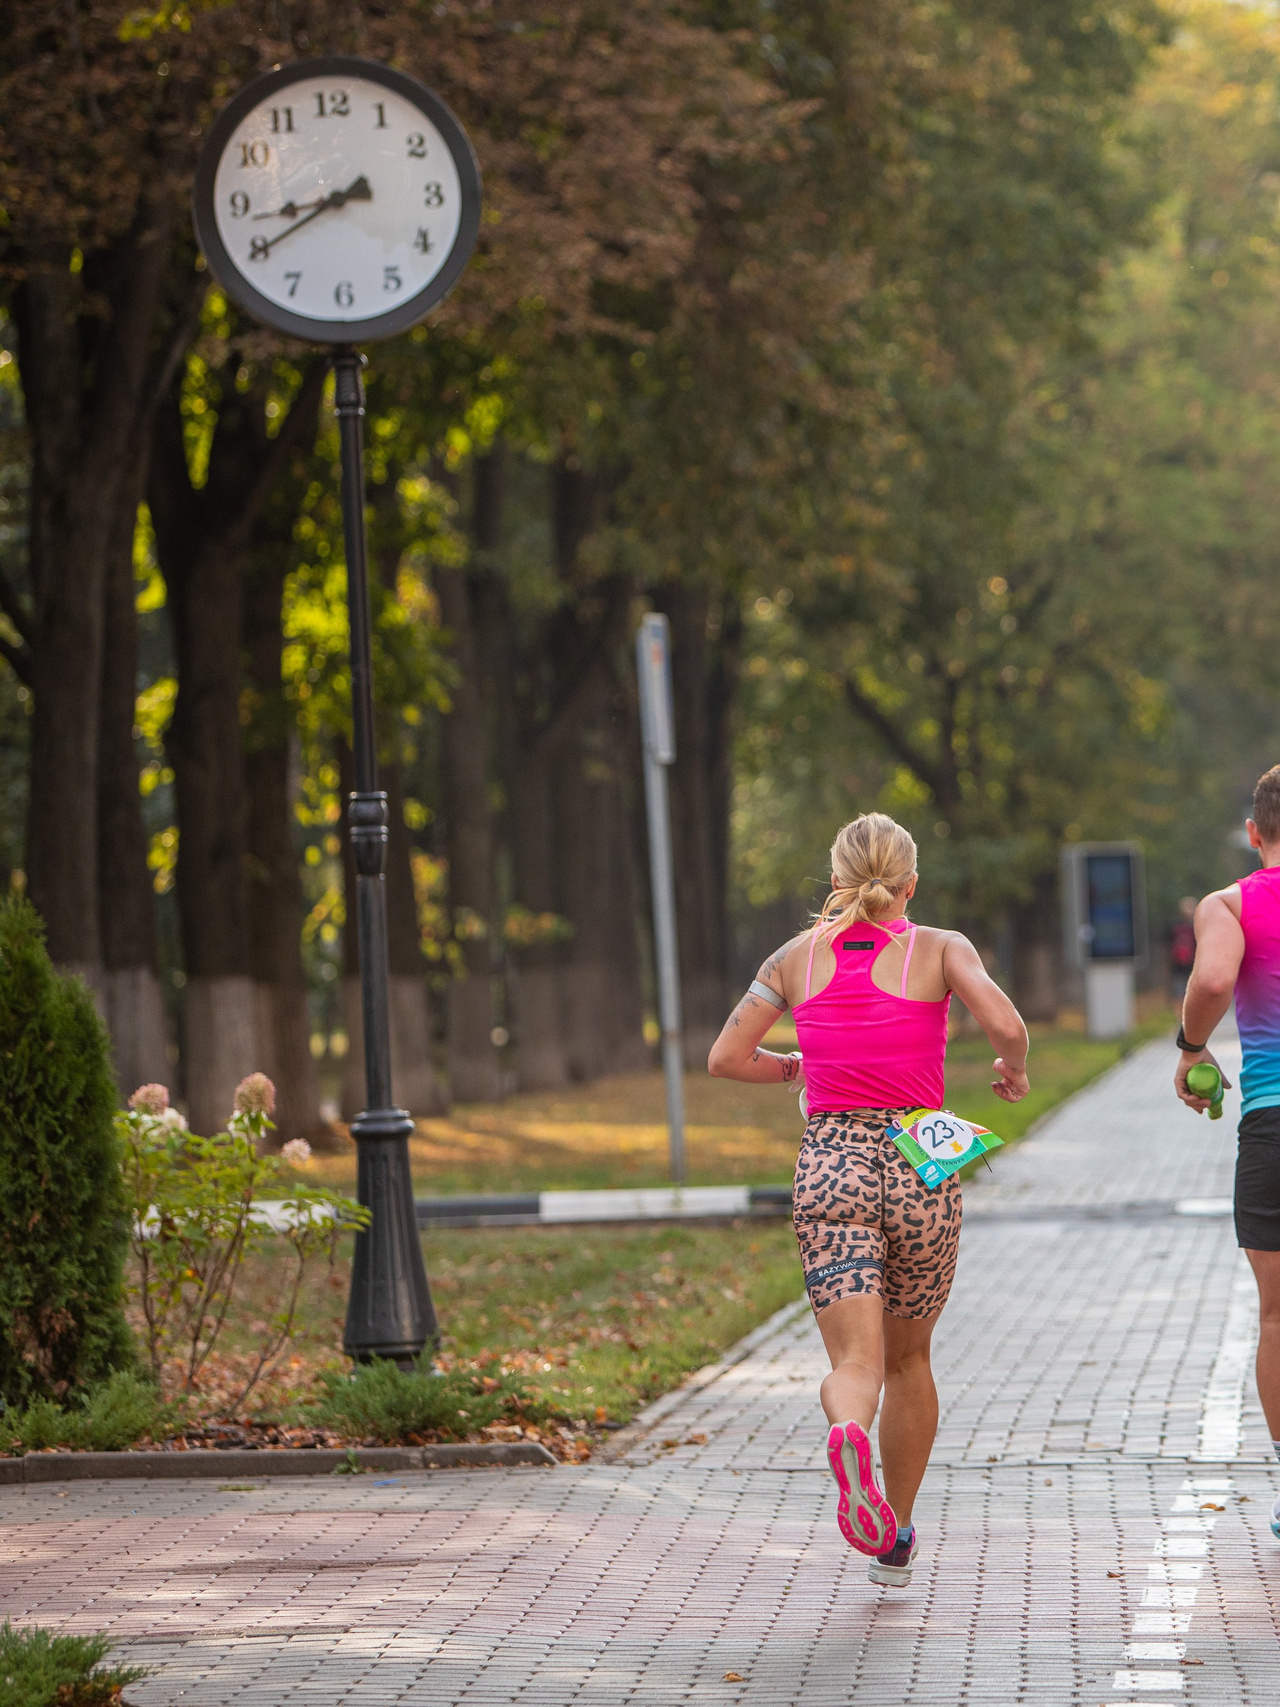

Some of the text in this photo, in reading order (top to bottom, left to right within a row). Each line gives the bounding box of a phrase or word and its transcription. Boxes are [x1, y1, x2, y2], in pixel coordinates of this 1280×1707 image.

[313, 90, 350, 118] 12
[375, 102, 389, 129] 1
[269, 106, 294, 134] 11
[239, 140, 270, 169] 10
[406, 131, 428, 160] 2
[229, 191, 250, 219] 9
[423, 182, 444, 210] 3
[413, 227, 434, 254] 4
[283, 271, 302, 298] 7
[383, 264, 402, 293] 5
[334, 281, 355, 309] 6
